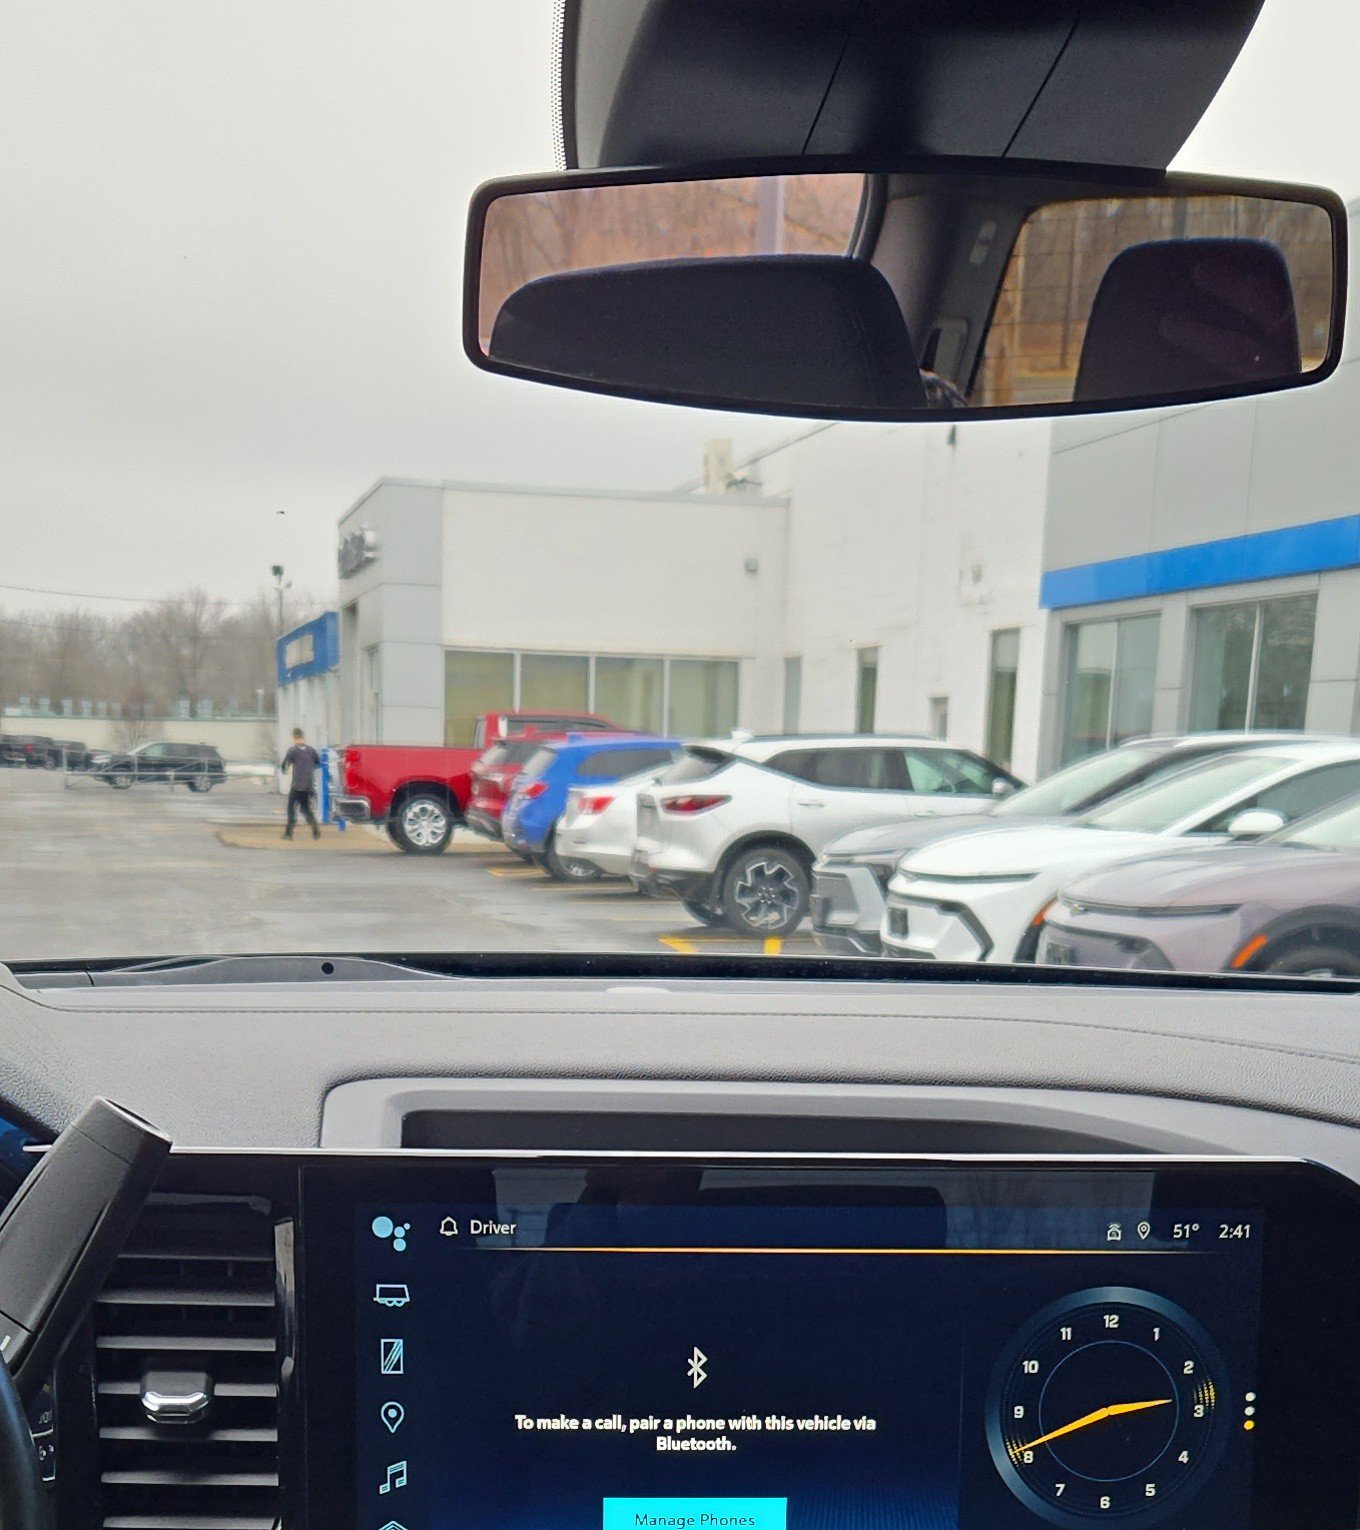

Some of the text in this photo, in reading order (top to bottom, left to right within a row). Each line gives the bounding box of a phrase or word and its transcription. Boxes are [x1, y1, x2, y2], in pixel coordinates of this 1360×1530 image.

[470, 1219, 517, 1235] Driver
[1172, 1223, 1200, 1239] 51°
[1218, 1224, 1251, 1239] 2:41
[1104, 1314, 1120, 1328] 12
[1060, 1327, 1072, 1340] 11
[1153, 1327, 1160, 1340] 1
[1022, 1360, 1039, 1374] 10
[1183, 1360, 1194, 1374] 2
[1014, 1405, 1024, 1418] 9
[1193, 1404, 1204, 1418] 3
[515, 1414, 876, 1434] To make a call, pair a phone with this vehicle via
[656, 1436, 737, 1451] Bluetooth.
[1023, 1450, 1034, 1464] 8
[1178, 1450, 1188, 1464] 4
[1055, 1483, 1066, 1496] 7
[1145, 1483, 1156, 1496] 5
[1100, 1496, 1110, 1509] 6
[634, 1513, 756, 1529] Manage Phones
